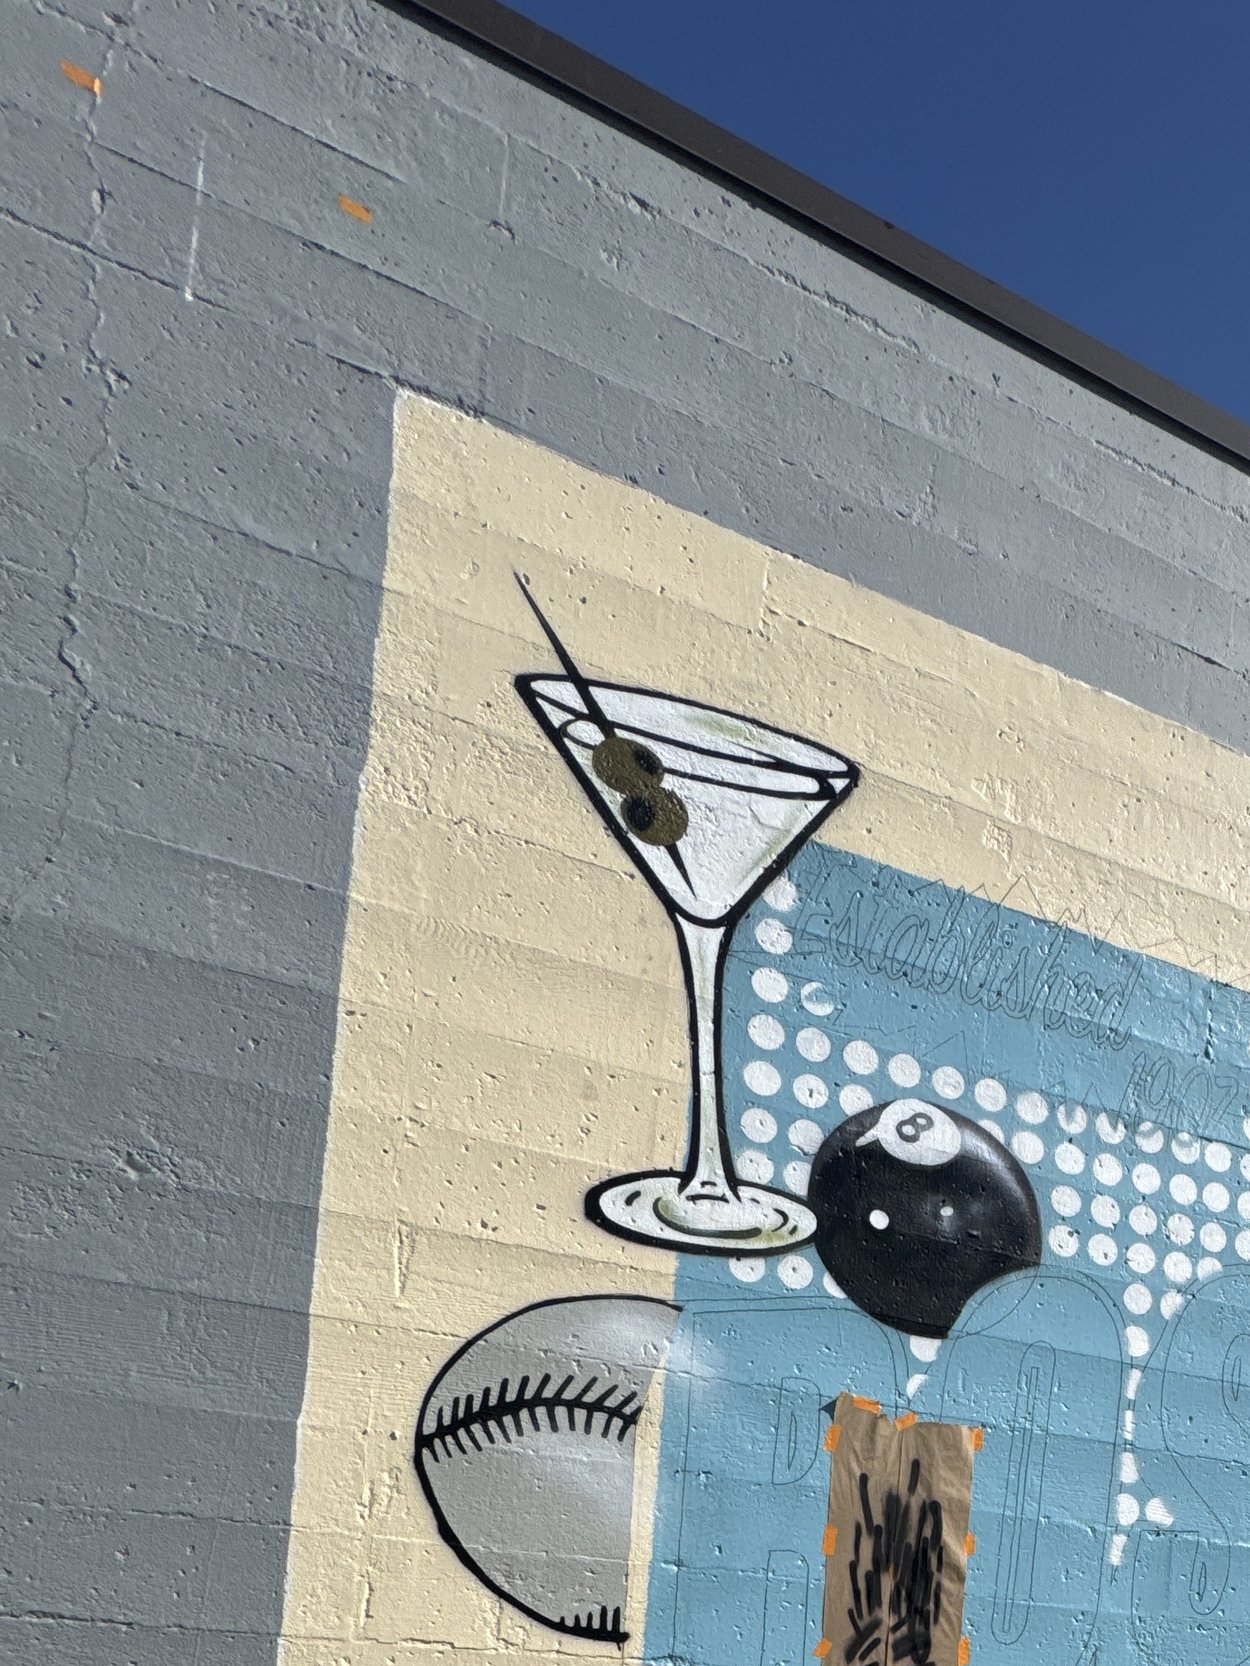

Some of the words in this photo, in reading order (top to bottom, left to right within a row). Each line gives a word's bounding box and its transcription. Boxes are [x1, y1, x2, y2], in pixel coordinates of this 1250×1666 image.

[793, 862, 1143, 1050] Established
[895, 1112, 935, 1143] 8
[1115, 1051, 1240, 1136] 1907
